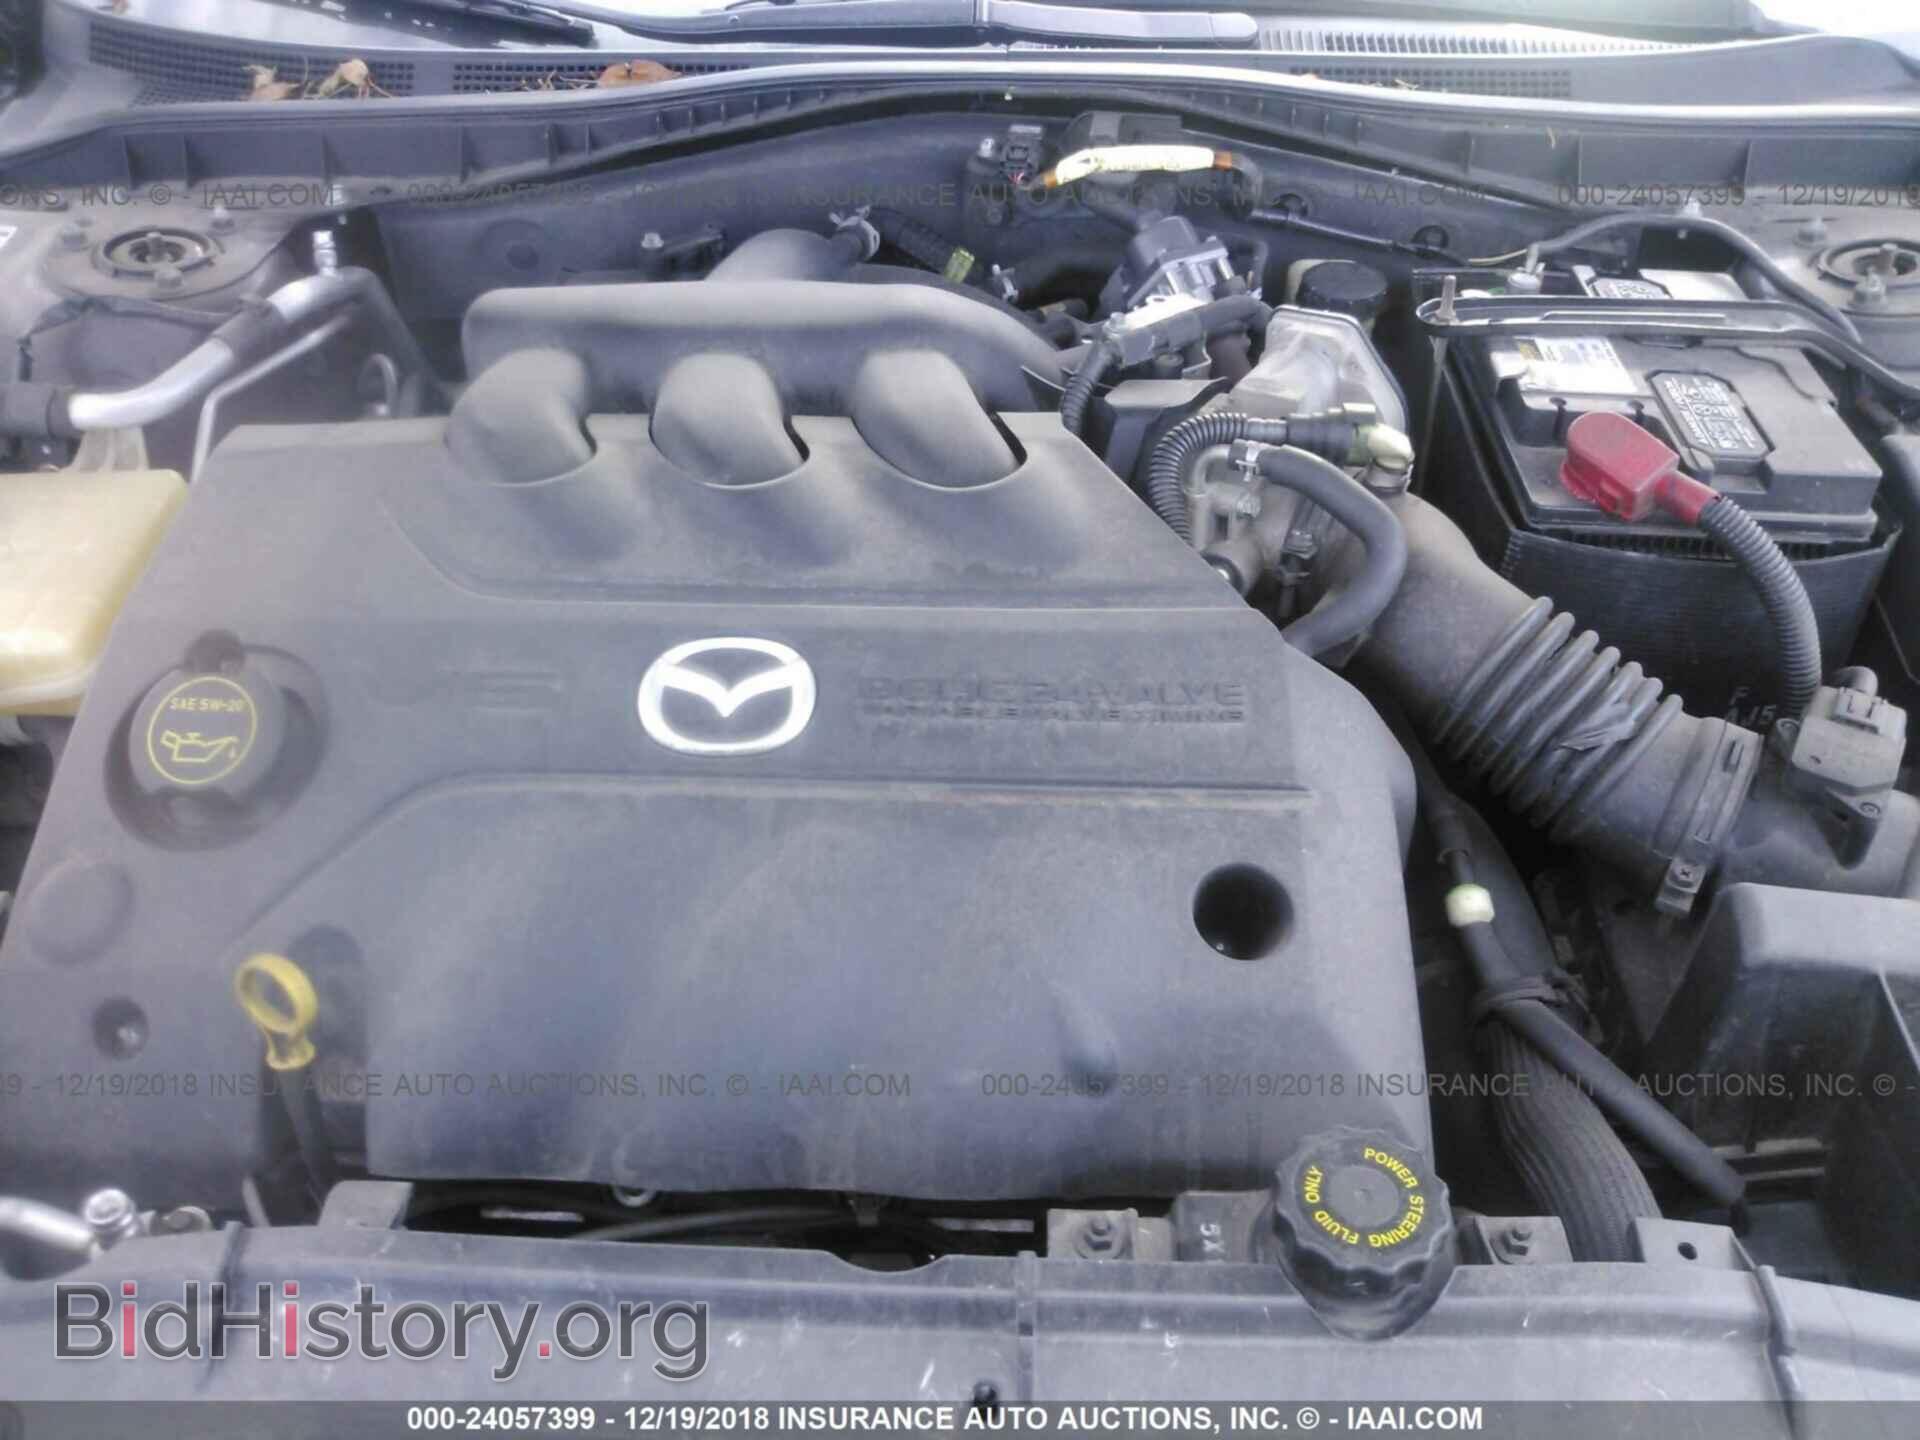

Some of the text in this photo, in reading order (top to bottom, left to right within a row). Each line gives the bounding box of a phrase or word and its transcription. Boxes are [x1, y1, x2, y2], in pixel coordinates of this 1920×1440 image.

[1304, 1148, 1424, 1247] POWER STEERING FLUID ONLY
